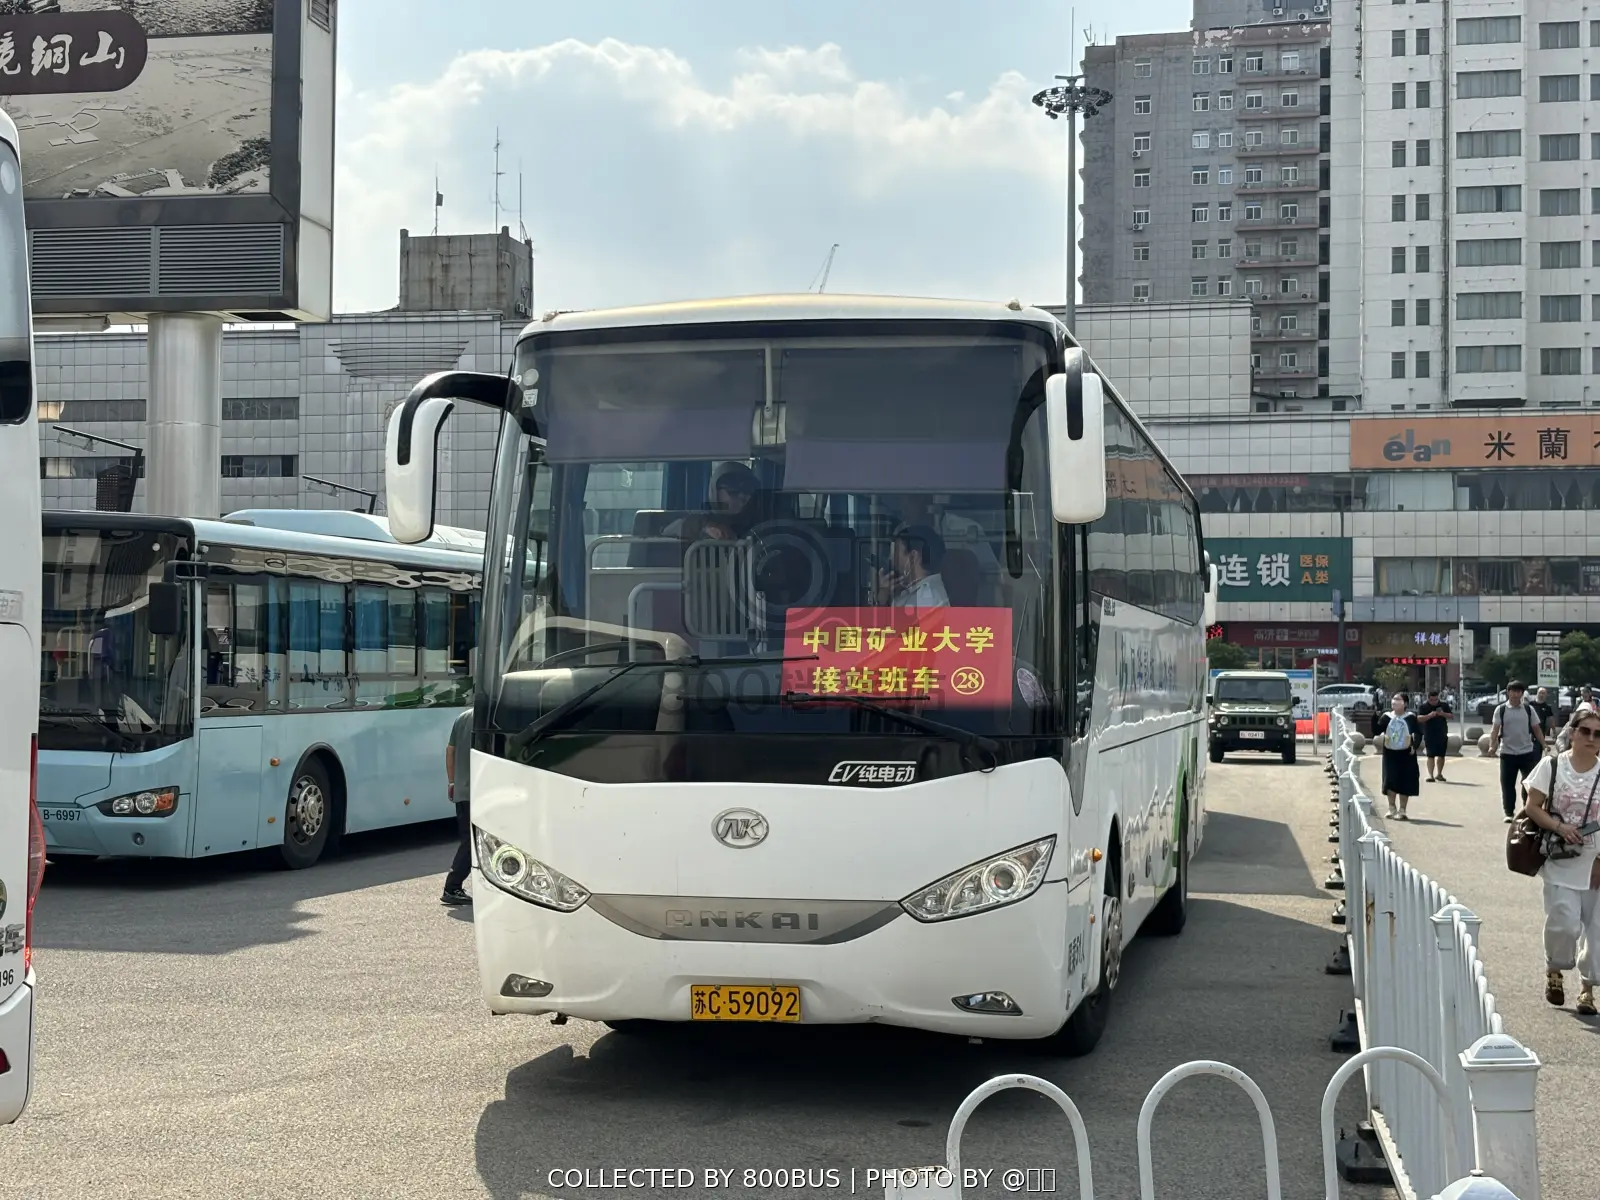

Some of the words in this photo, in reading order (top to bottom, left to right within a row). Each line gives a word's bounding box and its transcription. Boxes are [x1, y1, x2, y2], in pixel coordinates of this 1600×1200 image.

[1383, 428, 1451, 462] élan
[1483, 428, 1600, 460] 米蘭
[1217, 552, 1291, 587] 连锁
[803, 626, 995, 653] 中国矿业大学
[812, 666, 940, 694] 接站班车
[43, 809, 81, 822] B-6997
[665, 909, 819, 930] ANKAI
[0, 968, 14, 987] 96
